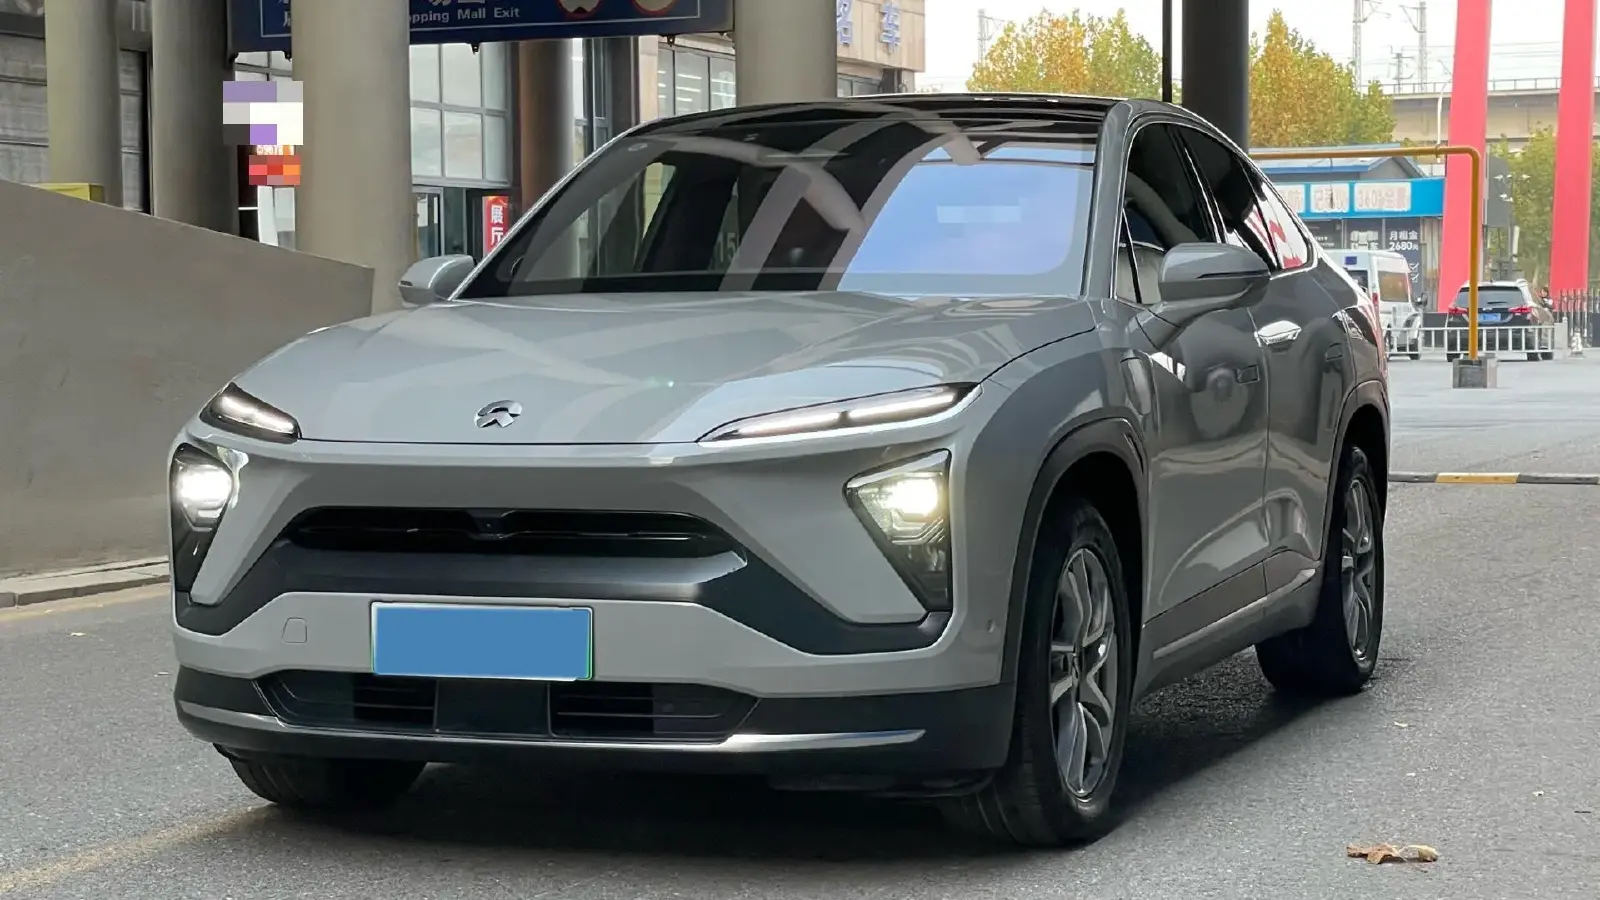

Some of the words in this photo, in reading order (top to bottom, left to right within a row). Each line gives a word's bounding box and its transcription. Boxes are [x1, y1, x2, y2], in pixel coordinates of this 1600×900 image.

[410, 11, 449, 23] pping
[457, 8, 486, 20] Mall
[493, 7, 520, 18] Exit
[491, 204, 504, 246] 展厅
